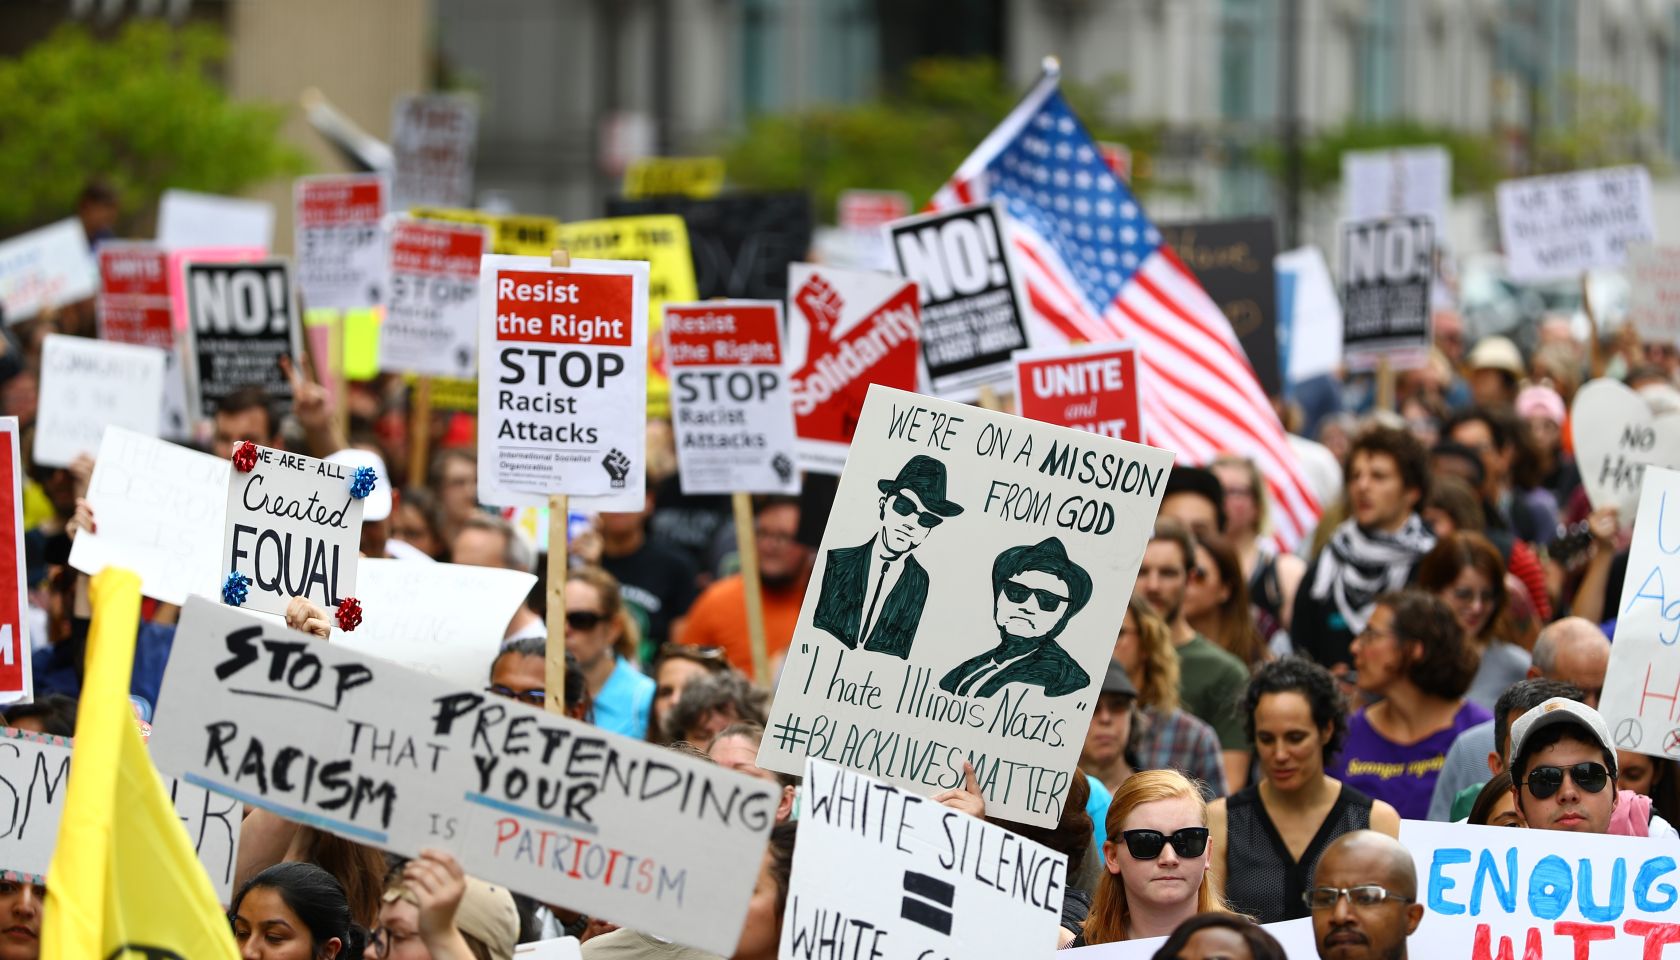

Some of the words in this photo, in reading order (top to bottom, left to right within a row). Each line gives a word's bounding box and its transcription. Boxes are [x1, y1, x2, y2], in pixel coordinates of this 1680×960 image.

[896, 211, 1008, 303] NO!
[1346, 220, 1431, 285] NO!
[193, 270, 288, 336] NO!
[499, 278, 580, 304] Resist
[498, 312, 543, 335] the
[550, 314, 623, 343] Right
[667, 312, 737, 333] Resist
[499, 348, 625, 389] STOP
[670, 342, 709, 361] the
[713, 339, 776, 366] Right
[790, 303, 921, 416] Solidarity
[1031, 357, 1124, 398] UNITE
[498, 390, 577, 414] Racist
[677, 370, 779, 403] STOP
[1064, 396, 1098, 419] and
[498, 418, 598, 444] Attacks
[679, 406, 746, 426] Racist
[683, 431, 767, 450] Attacks
[1620, 423, 1657, 452] NO
[256, 449, 272, 464] WE
[280, 455, 306, 472] ARE
[317, 462, 345, 480] ALL
[888, 403, 964, 451] WE'RE
[976, 423, 1013, 460] ON
[1013, 434, 1034, 467] A
[1038, 440, 1164, 498] MISSION
[243, 474, 352, 529] Created
[983, 480, 1052, 526] FROM
[1056, 495, 1115, 535] GOD
[231, 523, 345, 607] EQUAL
[826, 650, 882, 710] hate
[895, 664, 985, 728] Illinois
[215, 626, 373, 709] STOP
[432, 692, 772, 832] PRETENDING
[348, 719, 449, 773] THAT
[473, 754, 600, 823] YOUR
[773, 713, 1069, 822] #BLACKLIVESMATTER
[204, 721, 397, 829] RACISM
[428, 813, 458, 840] IS
[494, 817, 687, 907] PATRIOTISM
[810, 761, 922, 854] WHITE
[938, 812, 1064, 913] SILENCE
[1427, 846, 1680, 922] ENOUG
[791, 895, 888, 960] WHITE
